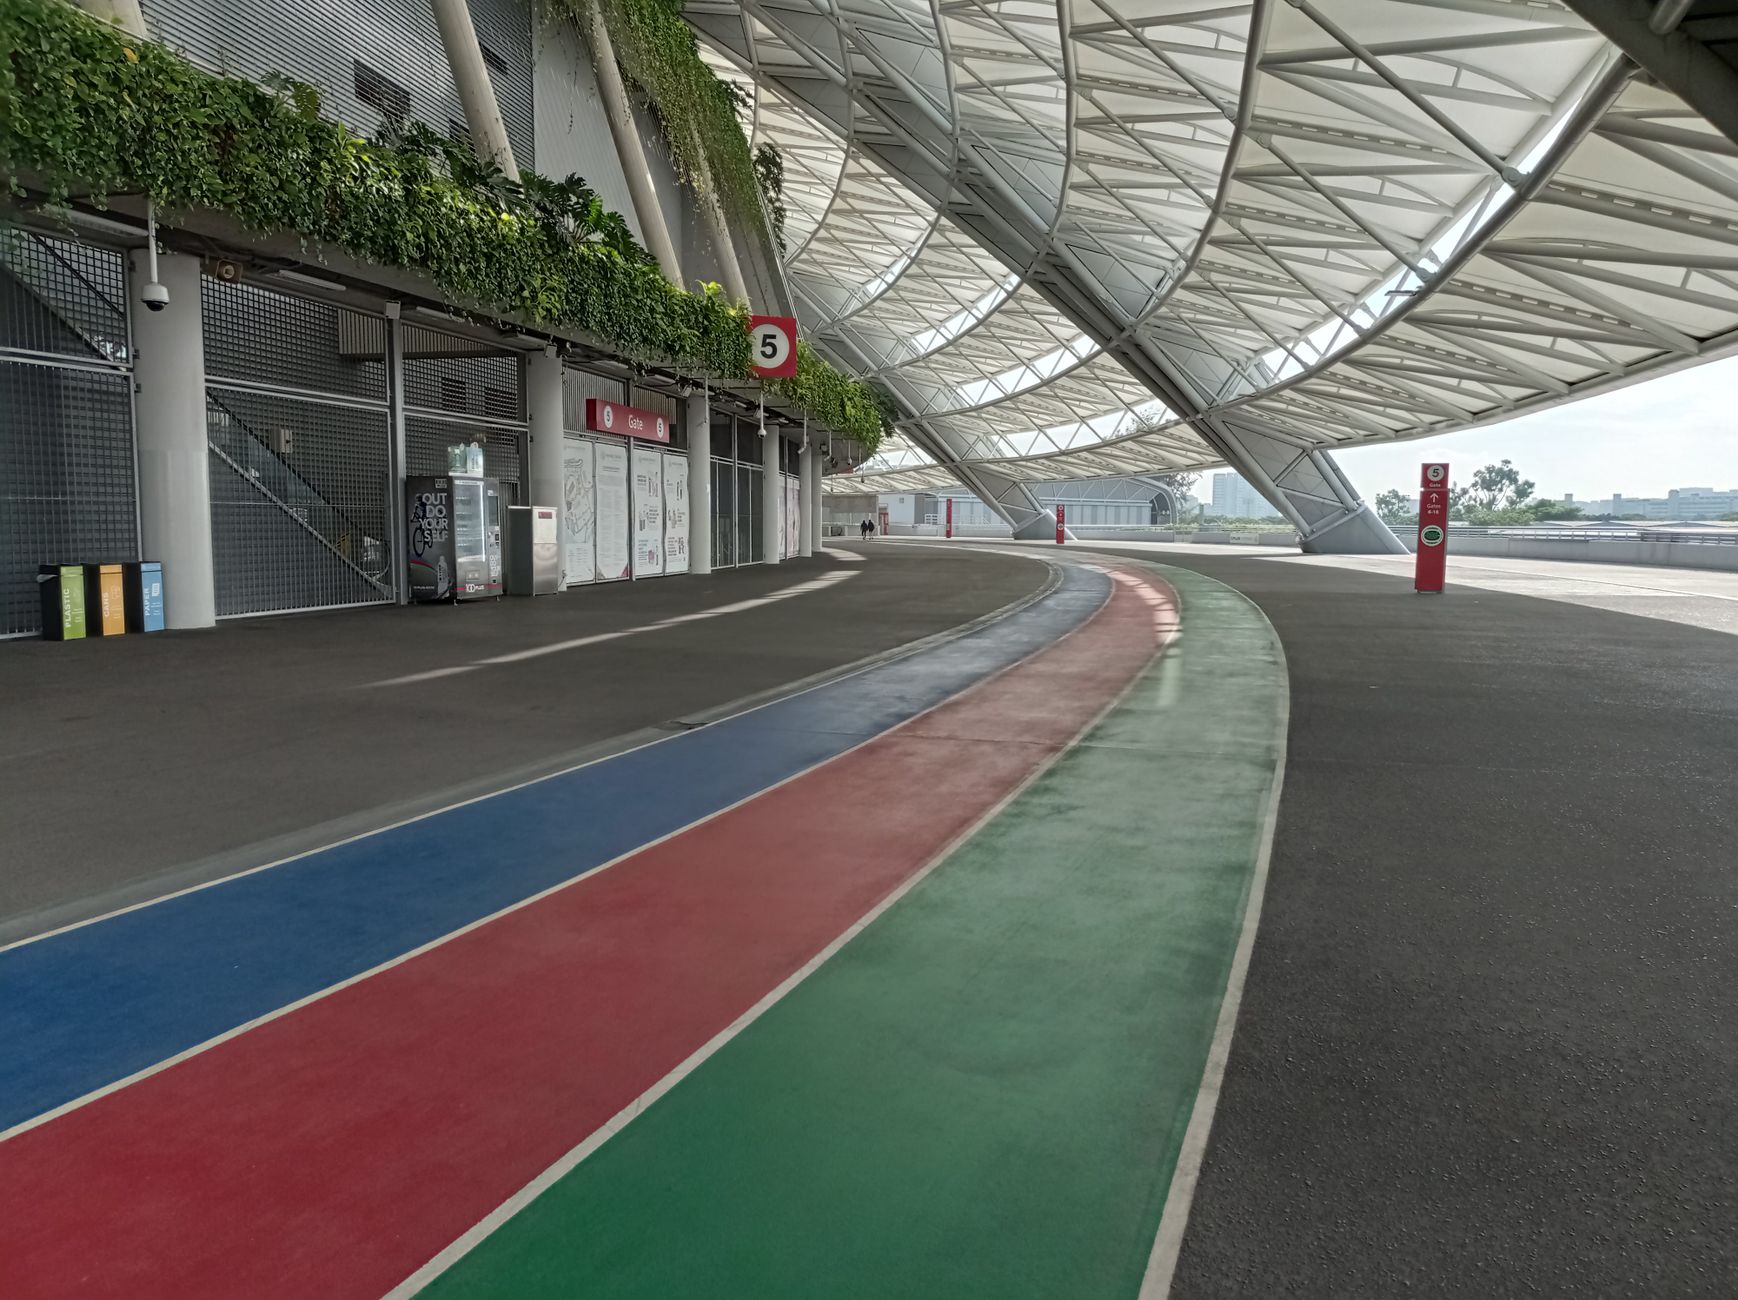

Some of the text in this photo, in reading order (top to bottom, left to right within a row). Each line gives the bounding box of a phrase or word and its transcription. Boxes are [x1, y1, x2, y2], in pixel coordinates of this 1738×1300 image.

[760, 334, 777, 359] 5
[606, 410, 662, 433] 5 Gate 5
[1432, 468, 1440, 478] 5
[422, 493, 448, 505] OUT
[425, 505, 446, 517] DO
[418, 518, 449, 530] YOUR
[424, 530, 448, 542] SELF
[63, 588, 72, 628] PLASTIC
[102, 592, 110, 617] CANS
[143, 588, 151, 616] PAPER
